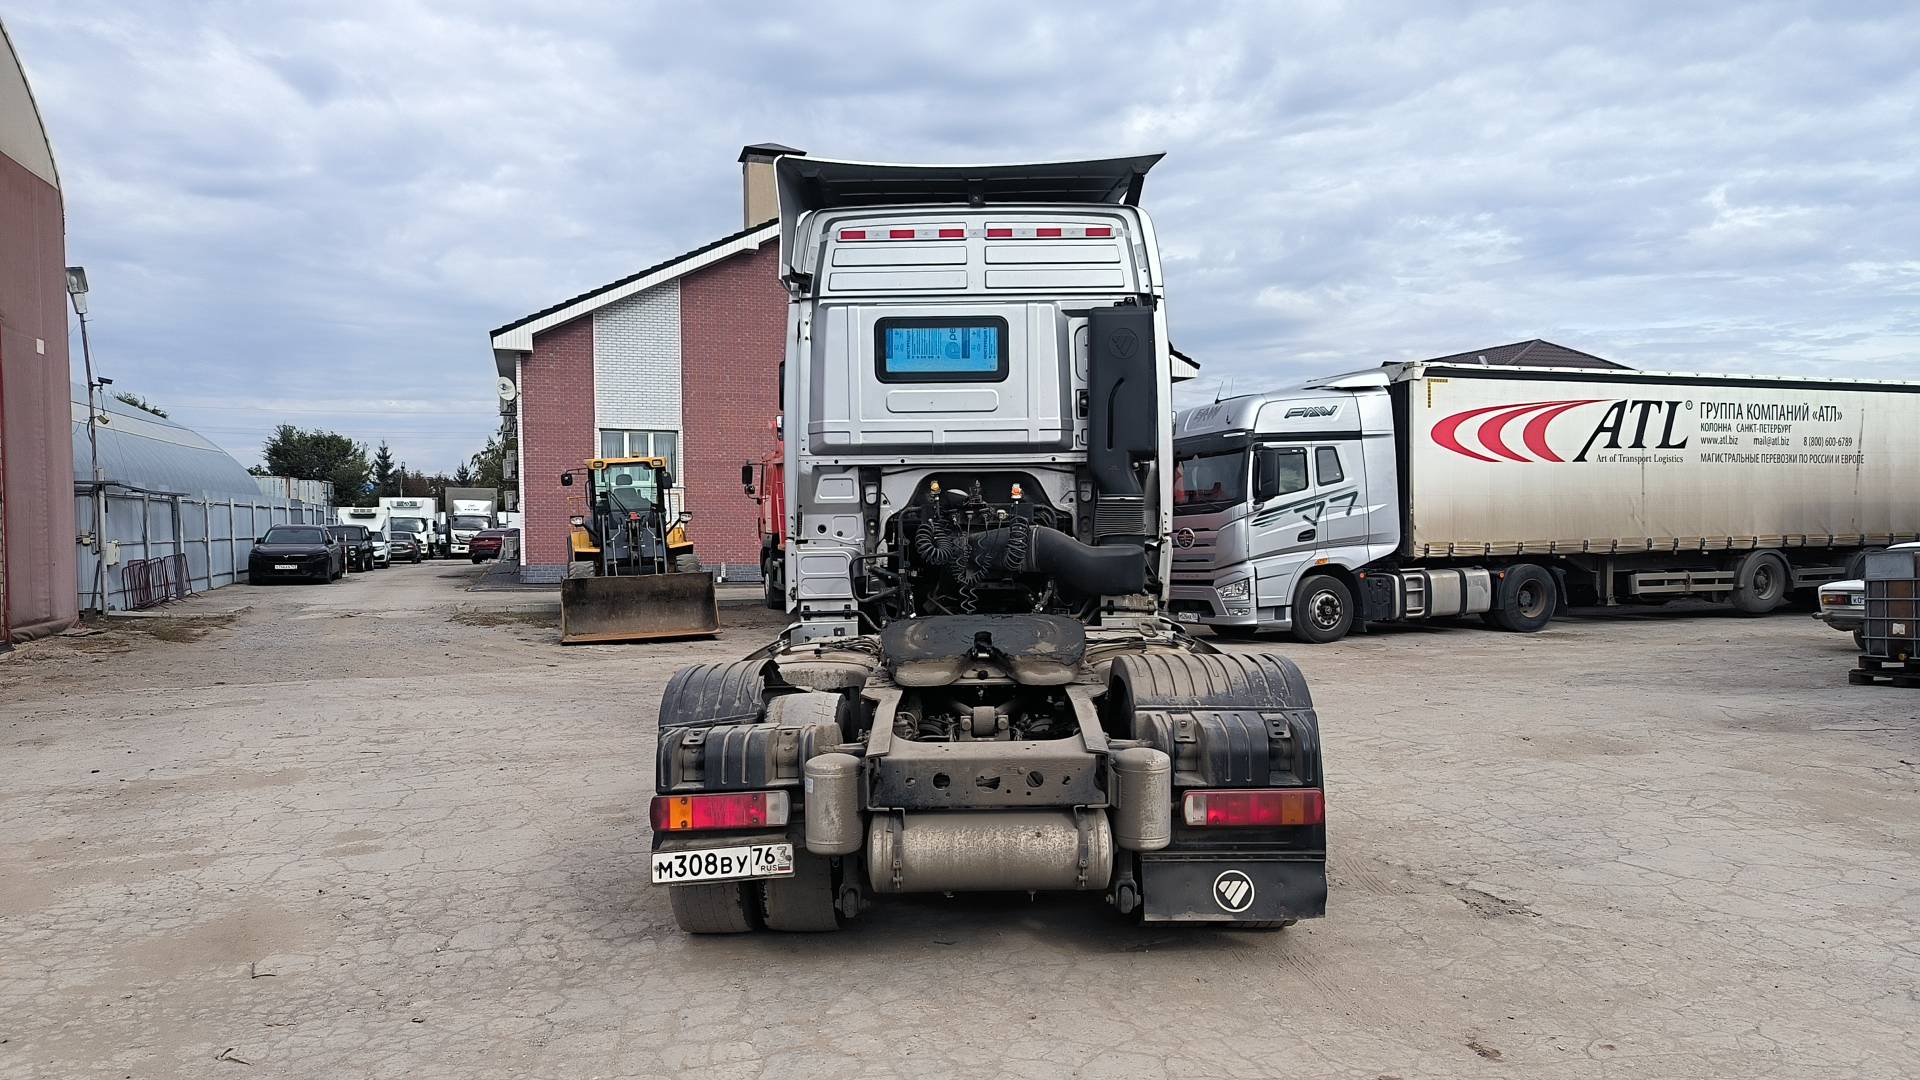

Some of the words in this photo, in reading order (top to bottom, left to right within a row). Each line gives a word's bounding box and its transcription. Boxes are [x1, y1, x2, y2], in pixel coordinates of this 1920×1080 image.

[1284, 405, 1338, 419] FAW
[1700, 402, 1743, 420] ГРУППА
[1747, 403, 1809, 421] КОМПАНИЙ
[1572, 399, 1688, 462] ATL
[1700, 422, 1732, 433] КОЛОННА
[1736, 423, 1792, 434] САНКТ-ПЕТЕРБУРГ
[1700, 435, 1739, 446] www.atl.biz
[1753, 436, 1790, 447] mail@atl.biz
[1803, 436, 1808, 446] 8
[1809, 436, 1824, 448] (800)
[1825, 437, 1853, 447] 600-6789
[1596, 455, 1609, 463] Art
[1609, 454, 1618, 463] of
[1618, 454, 1652, 465] Transport
[1654, 454, 1684, 465] Logistics
[1700, 453, 1760, 464] МАГИСТРАЛЬНЫЕ
[1761, 453, 1798, 464] ПЕРЕВОЗКИ
[1799, 454, 1808, 464] ПО
[1809, 454, 1834, 464] РОССИИ
[1835, 454, 1840, 464] И
[1841, 454, 1864, 465] ЕВРОПЕ
[753, 847, 776, 866] 76
[760, 864, 778, 872] RUS
